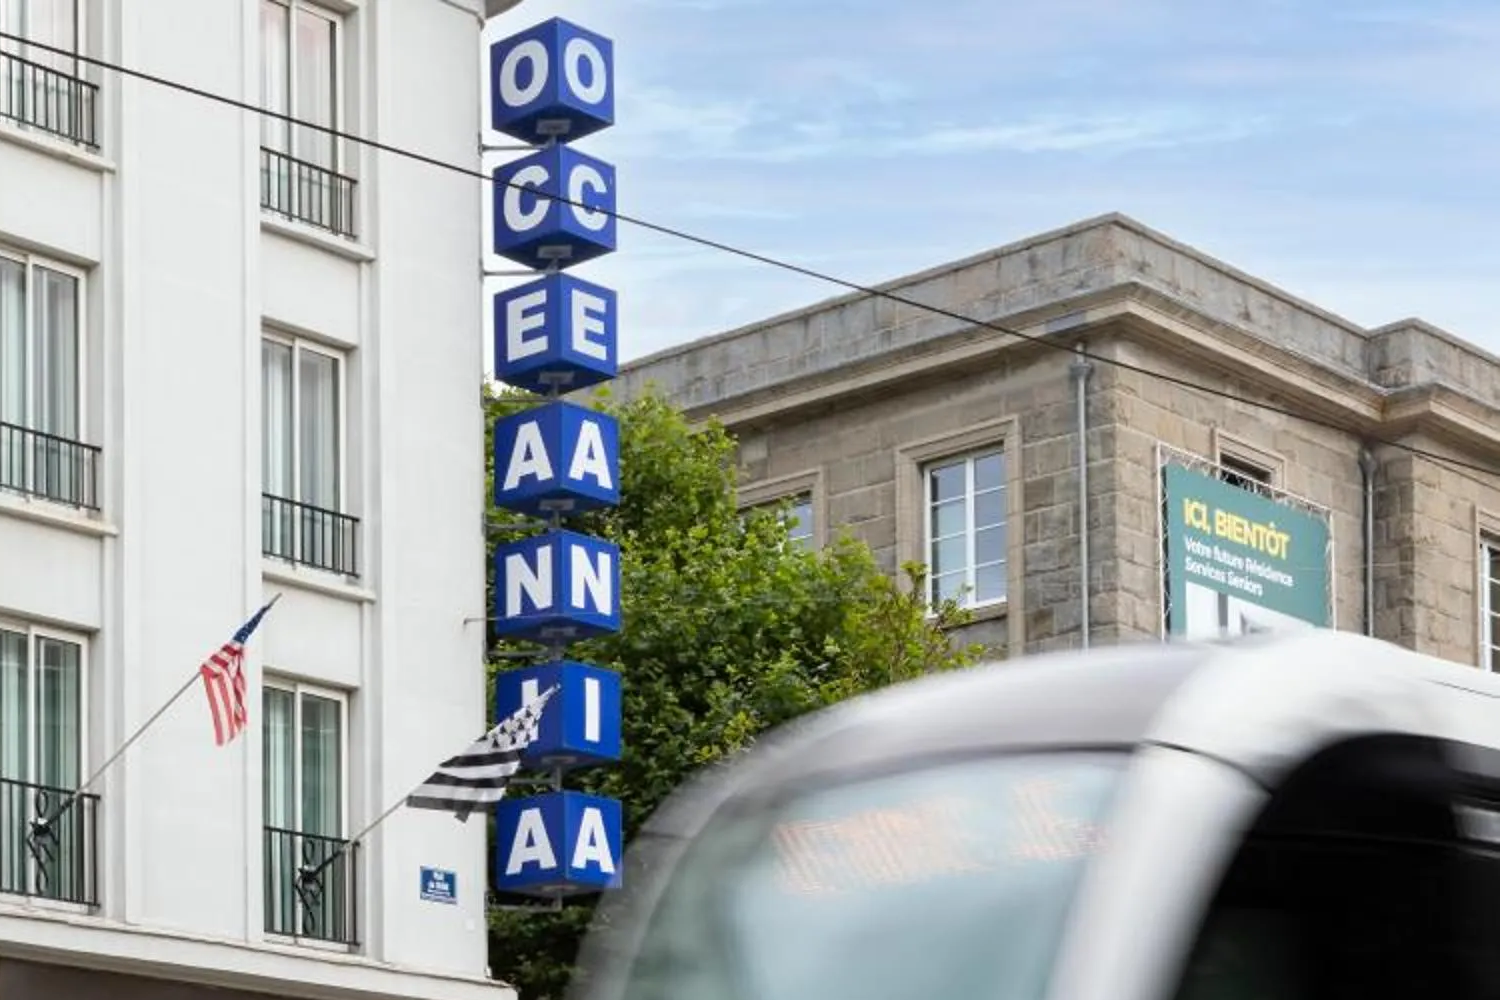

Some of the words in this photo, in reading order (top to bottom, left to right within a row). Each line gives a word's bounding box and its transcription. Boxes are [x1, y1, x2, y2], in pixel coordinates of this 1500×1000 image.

[563, 37, 616, 873] OCEANIA
[1184, 535, 1213, 558] Votre
[1214, 508, 1290, 560] BIENTÔT
[1184, 557, 1227, 584] Services
[1227, 570, 1264, 597] Seniors
